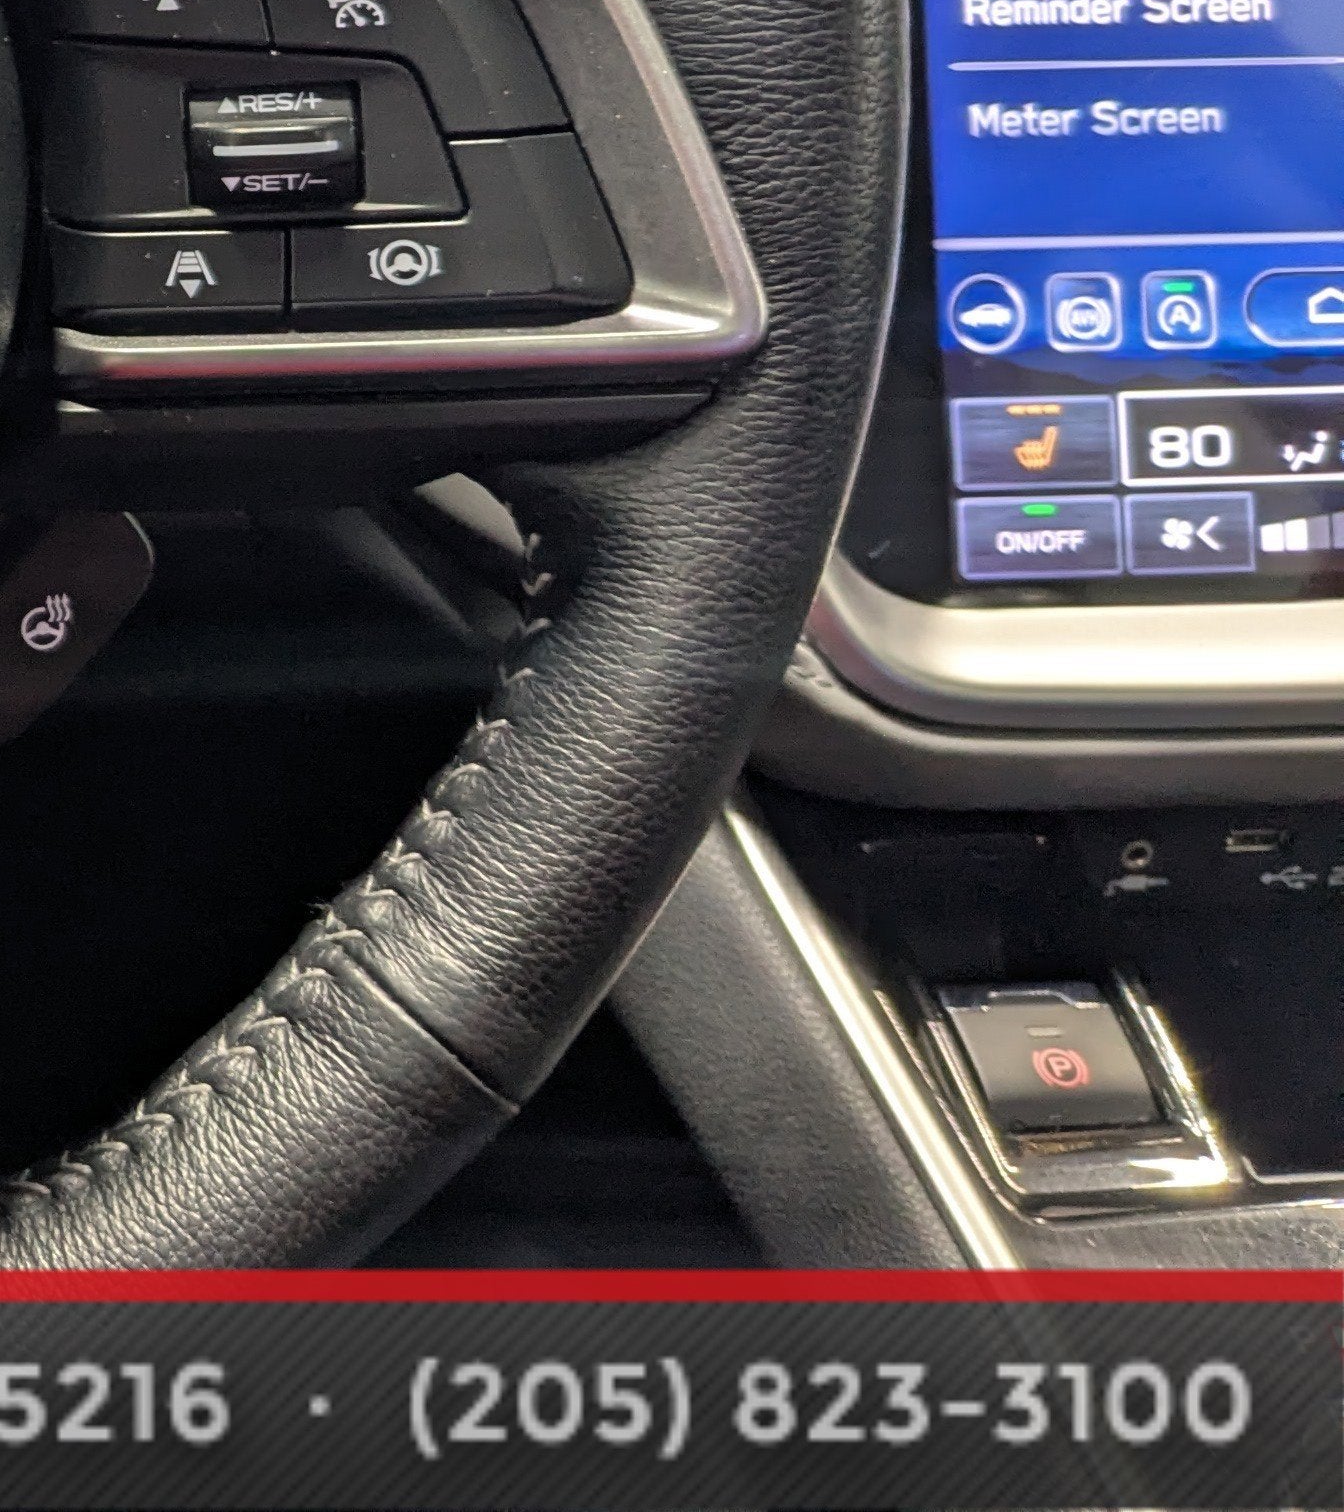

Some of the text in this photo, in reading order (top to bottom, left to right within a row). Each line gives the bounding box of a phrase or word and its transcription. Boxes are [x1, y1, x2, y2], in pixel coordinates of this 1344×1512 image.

[968, 100, 1225, 138] Meter Screen
[1148, 425, 1232, 468] 80
[996, 529, 1087, 554] ON/OFF
